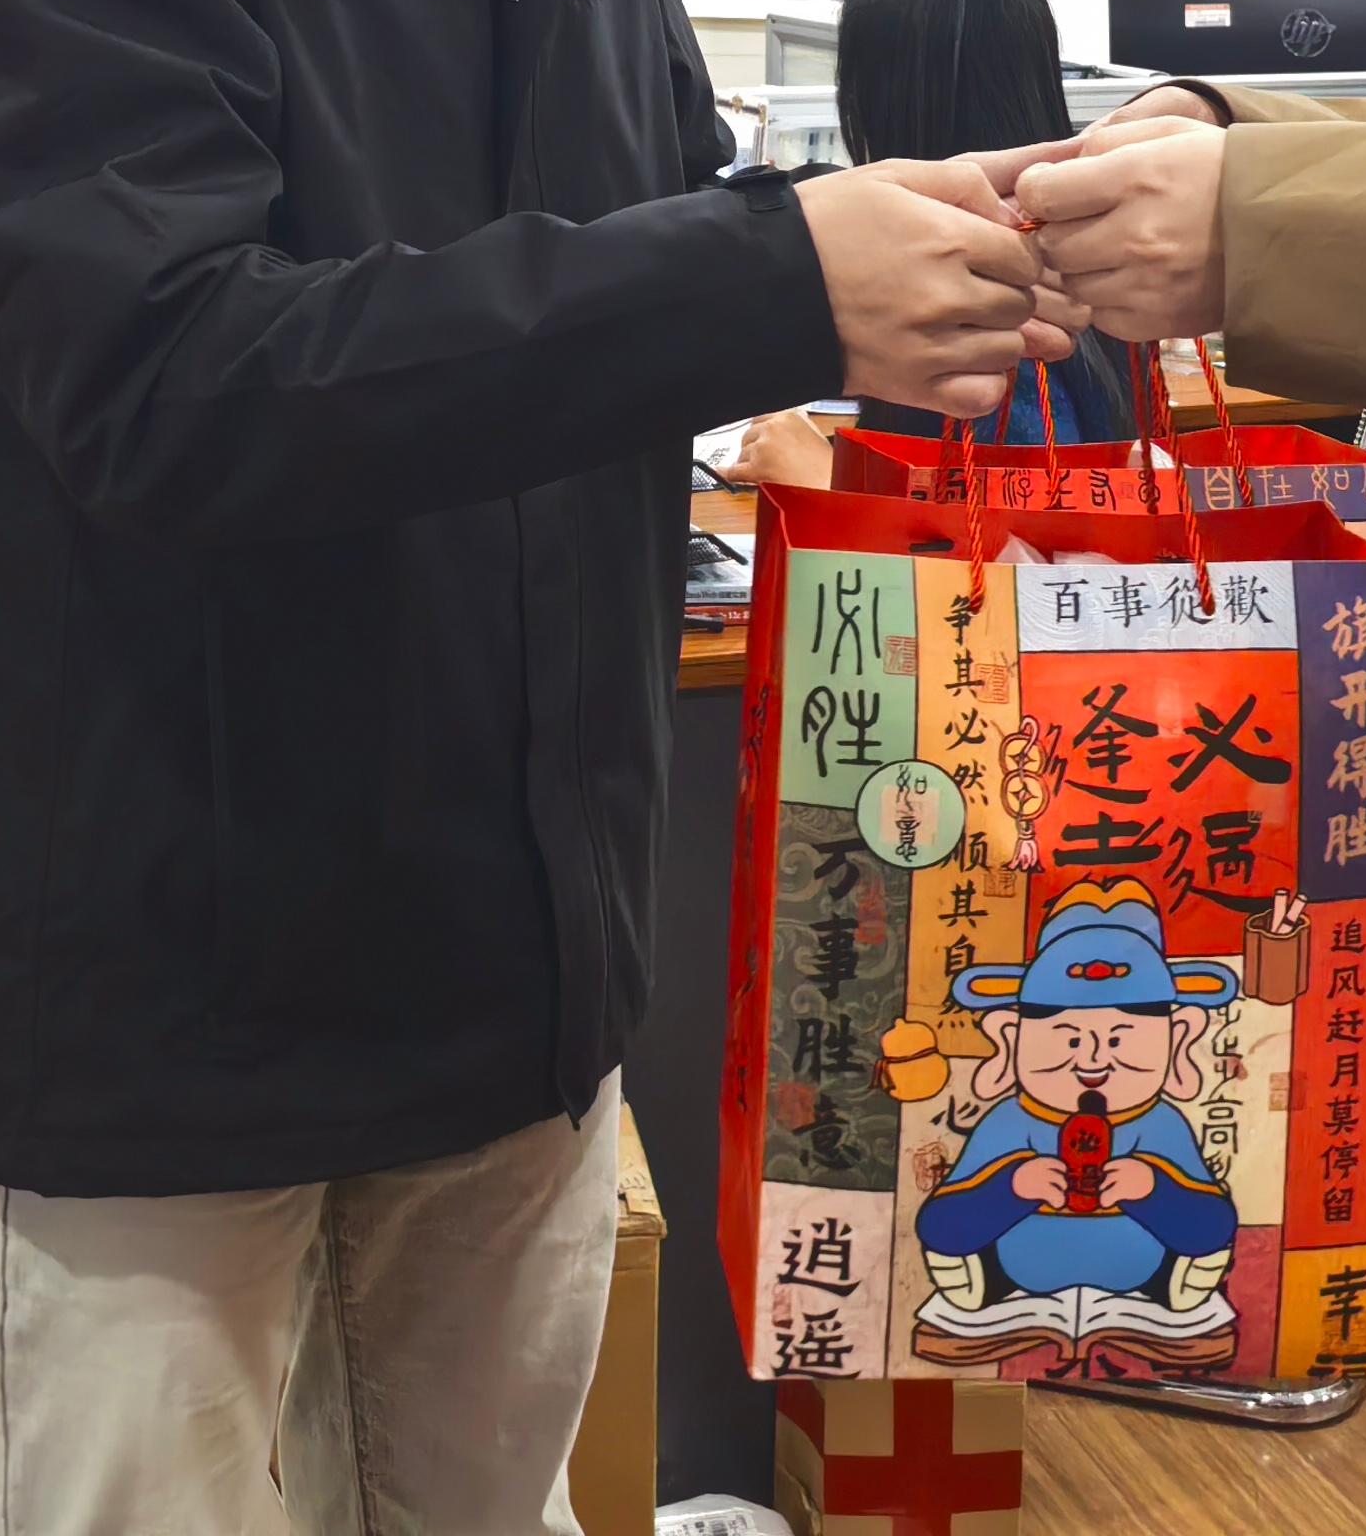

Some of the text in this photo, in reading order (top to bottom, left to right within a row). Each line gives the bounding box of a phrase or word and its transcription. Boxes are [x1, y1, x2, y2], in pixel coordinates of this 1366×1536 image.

[1320, 920, 1366, 1225] 追风赶月莫停留
[775, 1216, 861, 1380] 逍遥
